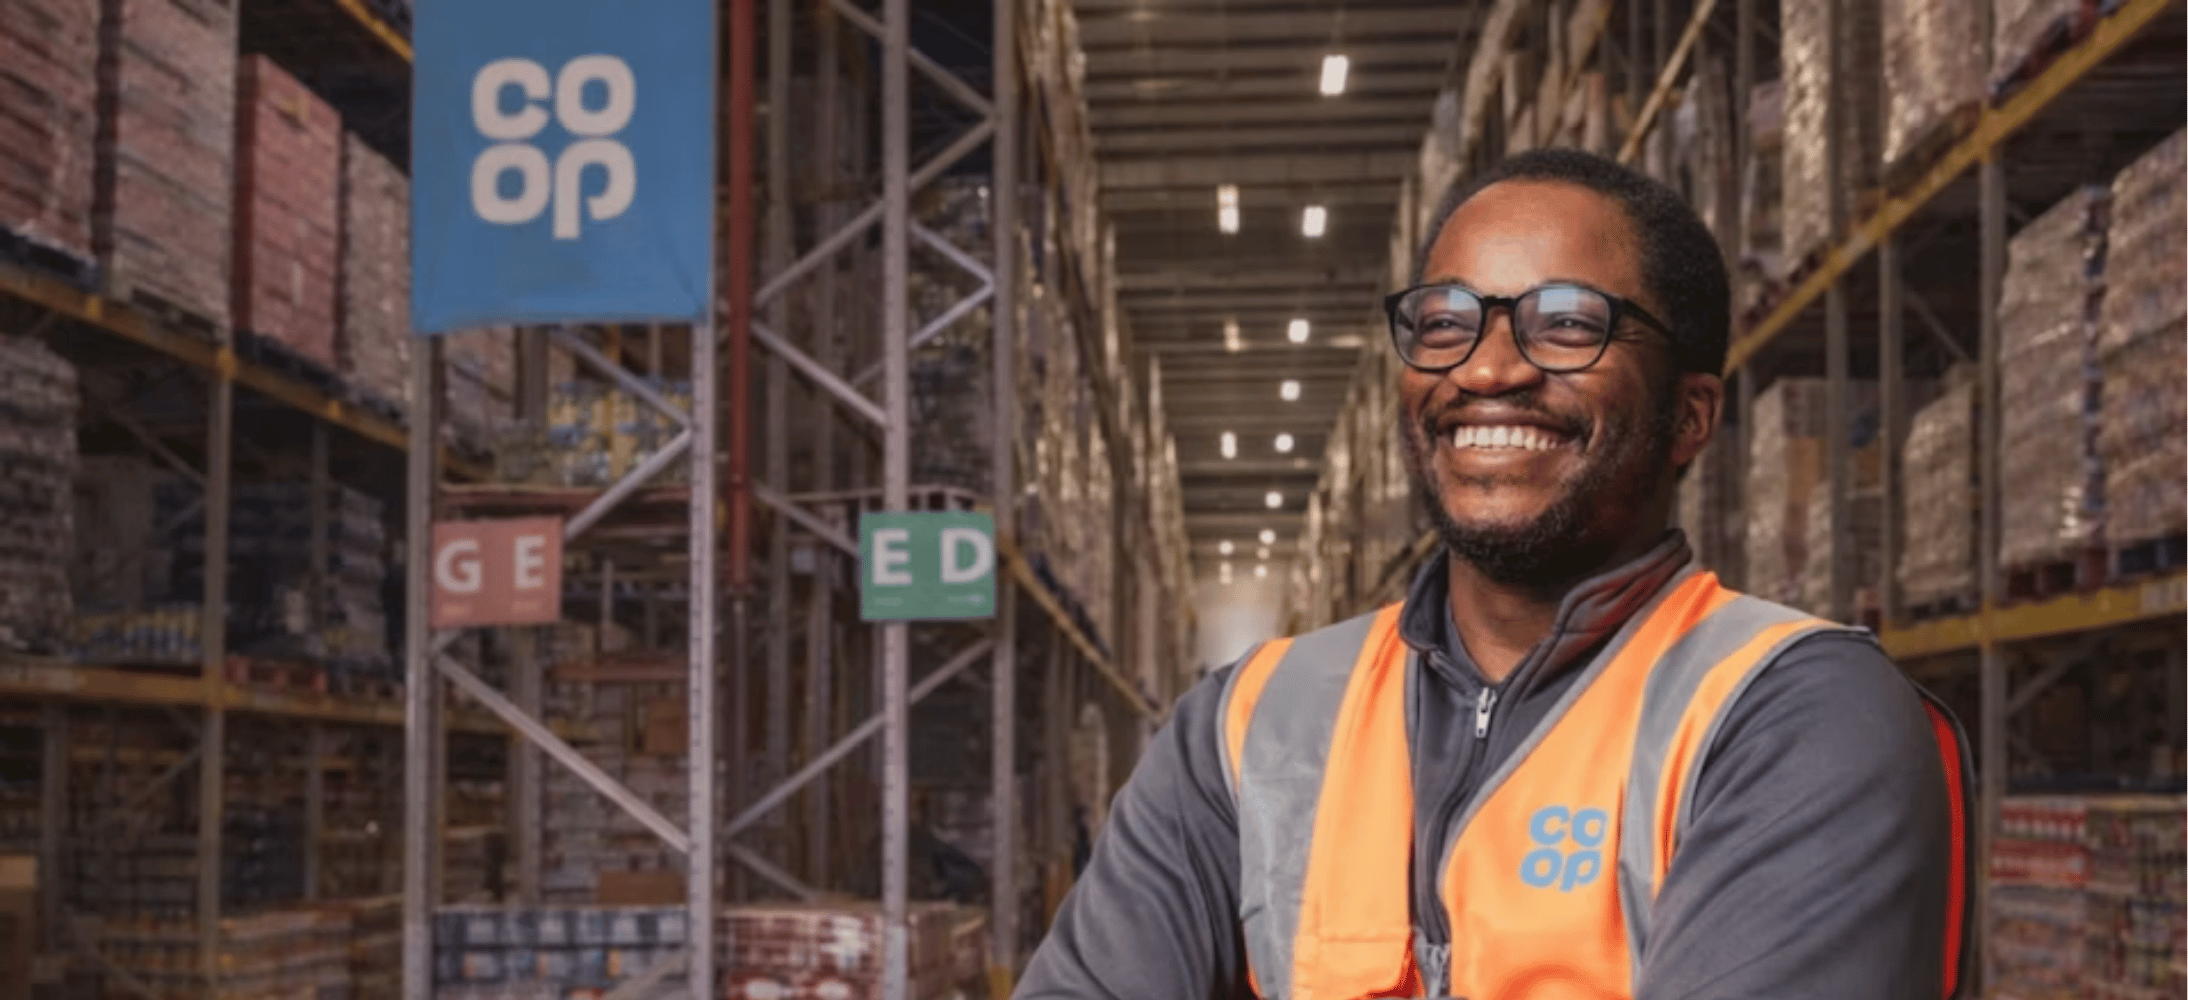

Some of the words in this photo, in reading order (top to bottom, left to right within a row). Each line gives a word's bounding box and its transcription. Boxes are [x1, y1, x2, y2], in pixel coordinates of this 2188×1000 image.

[435, 539, 482, 593] G
[514, 534, 546, 590] E
[872, 528, 912, 585] E
[940, 527, 994, 583] D
